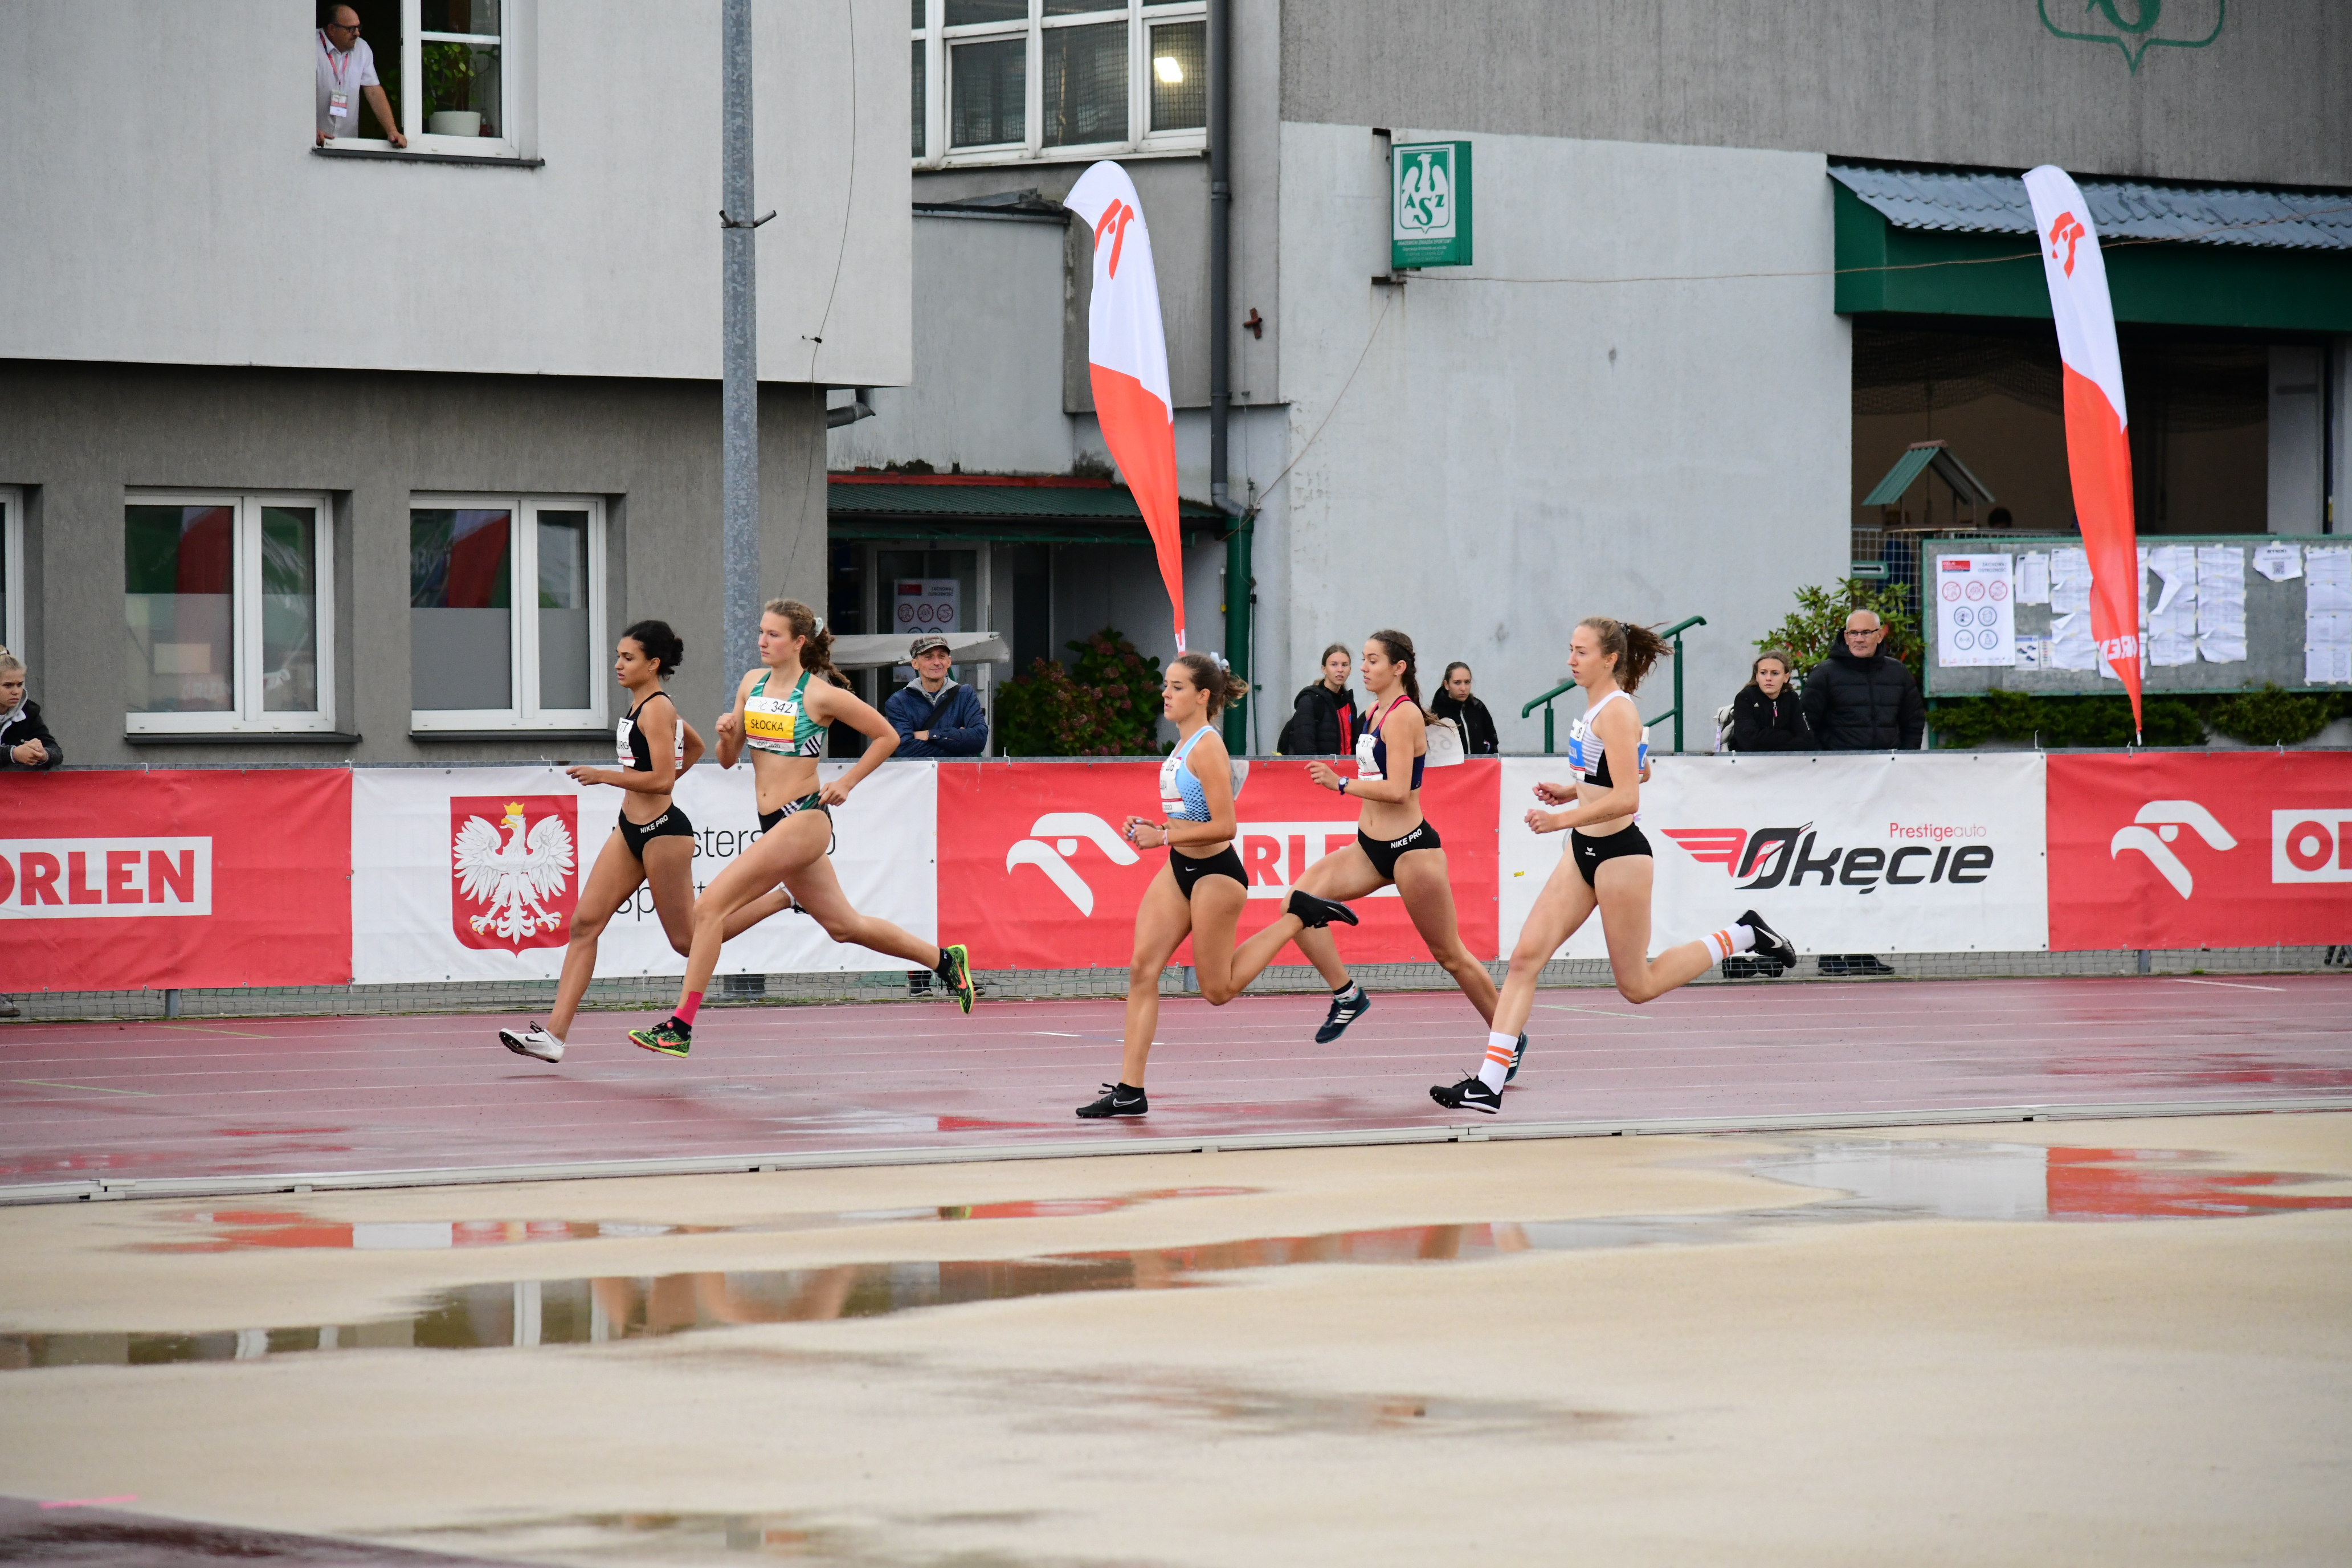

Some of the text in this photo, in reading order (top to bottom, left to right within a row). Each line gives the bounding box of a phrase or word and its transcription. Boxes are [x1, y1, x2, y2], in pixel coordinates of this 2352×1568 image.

[771, 701, 793, 713] 342
[750, 719, 783, 732] SŁOCKA
[640, 814, 669, 834] NIKE PRO
[1890, 823, 1986, 842] Prestigeauto
[1390, 828, 1423, 850] NIKE PRO
